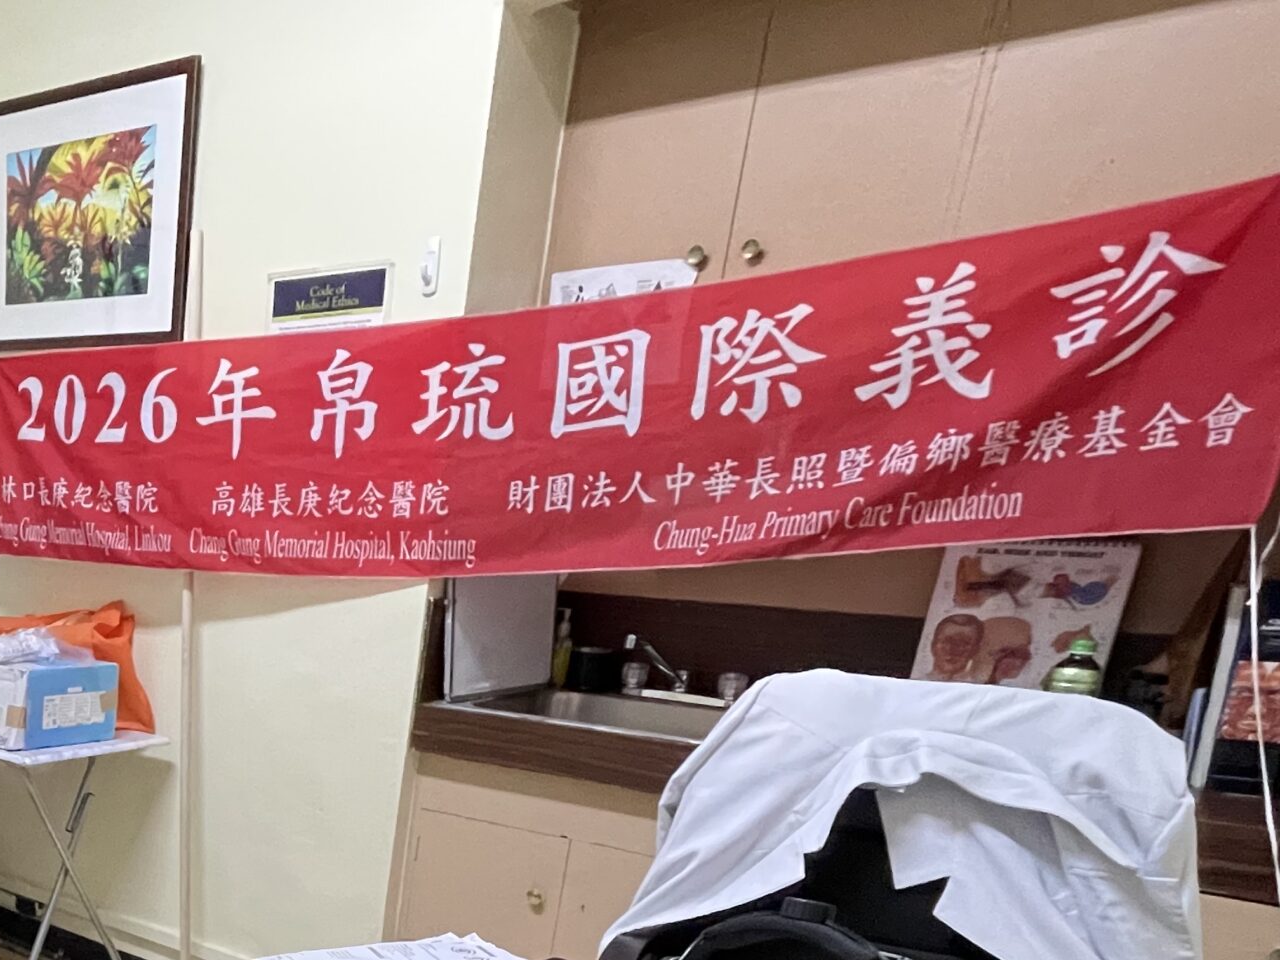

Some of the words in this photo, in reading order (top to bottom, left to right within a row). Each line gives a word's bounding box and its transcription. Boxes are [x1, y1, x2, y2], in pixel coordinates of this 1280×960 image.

[295, 296, 330, 312] Medical
[331, 294, 360, 308] Ethics
[309, 284, 334, 298] Code
[335, 281, 347, 295] of
[16, 231, 1226, 460] 2026年帛琉國際義診
[507, 392, 1255, 515] 財團法人中華長照暨偏鄉醫療基金會
[1, 475, 159, 514] 林口長庚紀念醫院
[211, 479, 450, 519] 高雄長庚紀念醫院
[20, 517, 48, 550] Gung
[48, 519, 86, 547] Memorial
[86, 521, 131, 556] Hospital,
[134, 525, 173, 553] Linkou
[654, 514, 753, 556] Chung-Hua
[759, 507, 840, 540] Primary
[845, 496, 894, 530] Care
[897, 482, 1023, 525] Foundation
[189, 527, 227, 562] Chang
[228, 529, 261, 564] Gung
[264, 530, 328, 559] Memorial
[332, 531, 396, 567] Hospital,
[399, 529, 477, 568] Kaohsiung
